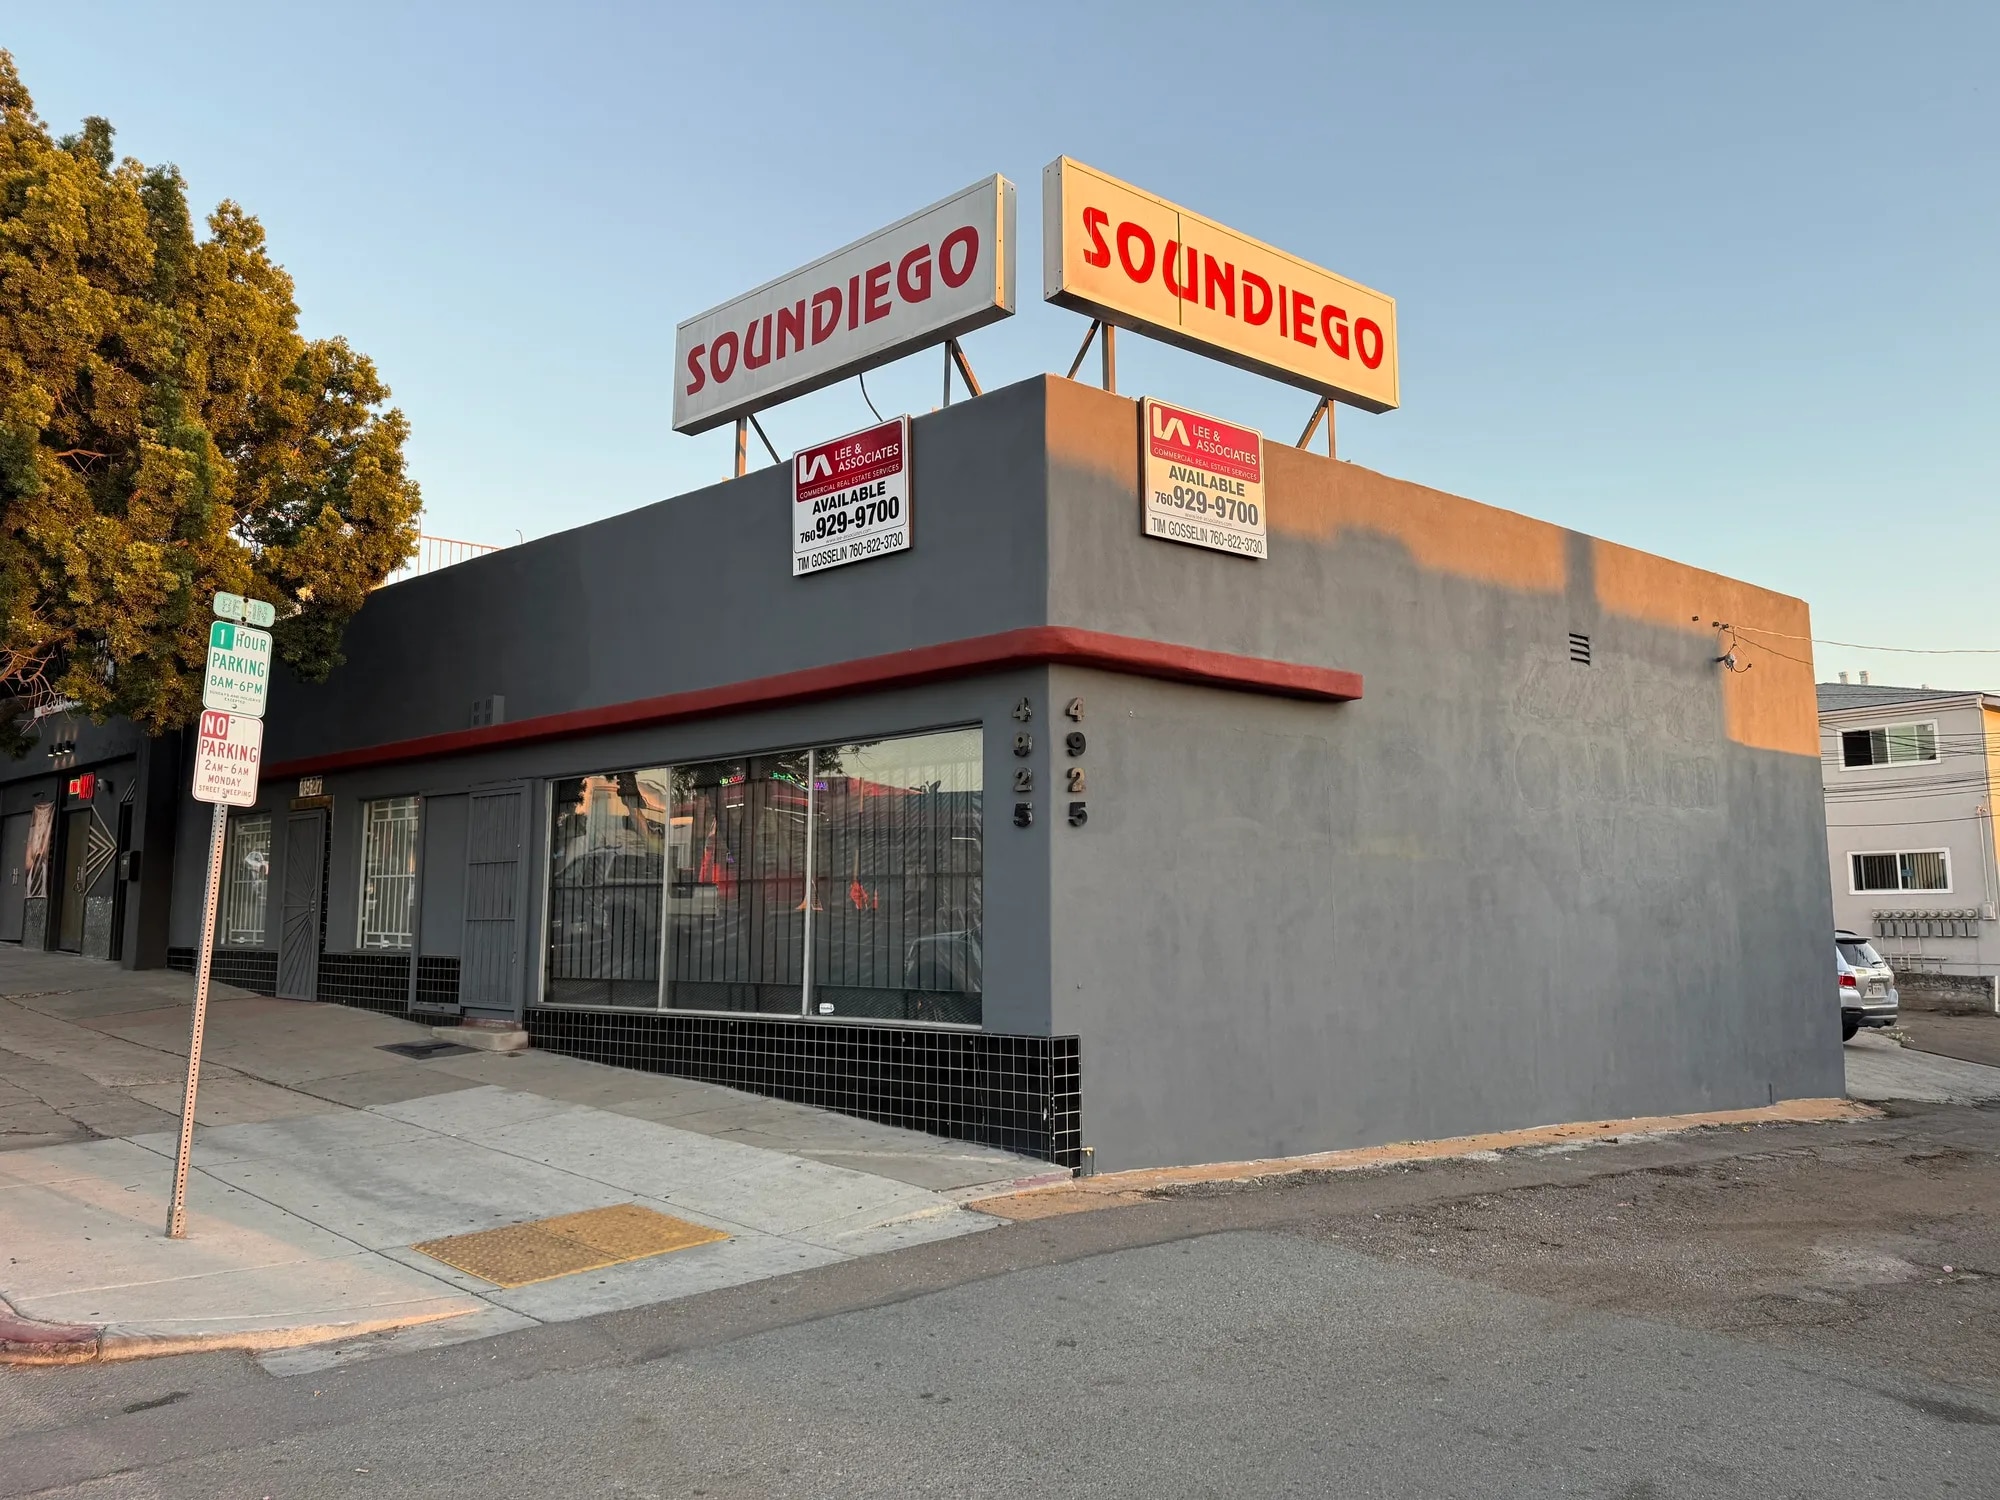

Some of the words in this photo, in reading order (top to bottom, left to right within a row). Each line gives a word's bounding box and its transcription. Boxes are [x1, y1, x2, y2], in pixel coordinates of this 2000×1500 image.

[1082, 206, 1384, 370] SOUNDIEGO
[686, 225, 979, 396] SOUNDIEGO
[1192, 424, 1210, 440] LEE
[1213, 430, 1221, 442] &
[834, 447, 852, 461] LEE
[854, 443, 862, 454] &
[838, 443, 899, 473] ASSOCIATES
[1154, 447, 1194, 464] COMMERCIAL
[1195, 458, 1209, 468] REAL
[1211, 462, 1231, 474] ESTATE
[1231, 467, 1258, 481] SERVICES
[1196, 439, 1257, 465] ASSOCIATES
[800, 484, 836, 499] COMMERCIAL
[836, 478, 851, 488] REAL
[851, 473, 872, 485] ESTATE
[872, 463, 900, 478] SERVICES
[1169, 465, 1246, 497] AVAILABLE
[812, 481, 886, 515] AVAILABLE
[1155, 491, 1173, 507] 760
[1173, 485, 1259, 526] 929-9700
[800, 529, 815, 544] 760
[815, 496, 900, 539] 929-9700
[1152, 517, 1166, 534] TIM
[1168, 521, 1208, 543] GOSSELIN
[1210, 530, 1263, 555] 760-822-3730
[797, 557, 810, 572] TIM
[811, 547, 848, 568] GOSSELIN
[849, 531, 904, 559] 760-822-3730
[220, 629, 226, 646] 1
[236, 633, 267, 652] HOUR
[212, 652, 265, 678] PARKING
[210, 674, 263, 695] 8AM-6PM
[203, 714, 227, 737] NO
[201, 739, 258, 763] PARKING
[198, 784, 220, 794] STREET
[222, 787, 252, 798] SWEEPING
[207, 774, 242, 787] MONDAY
